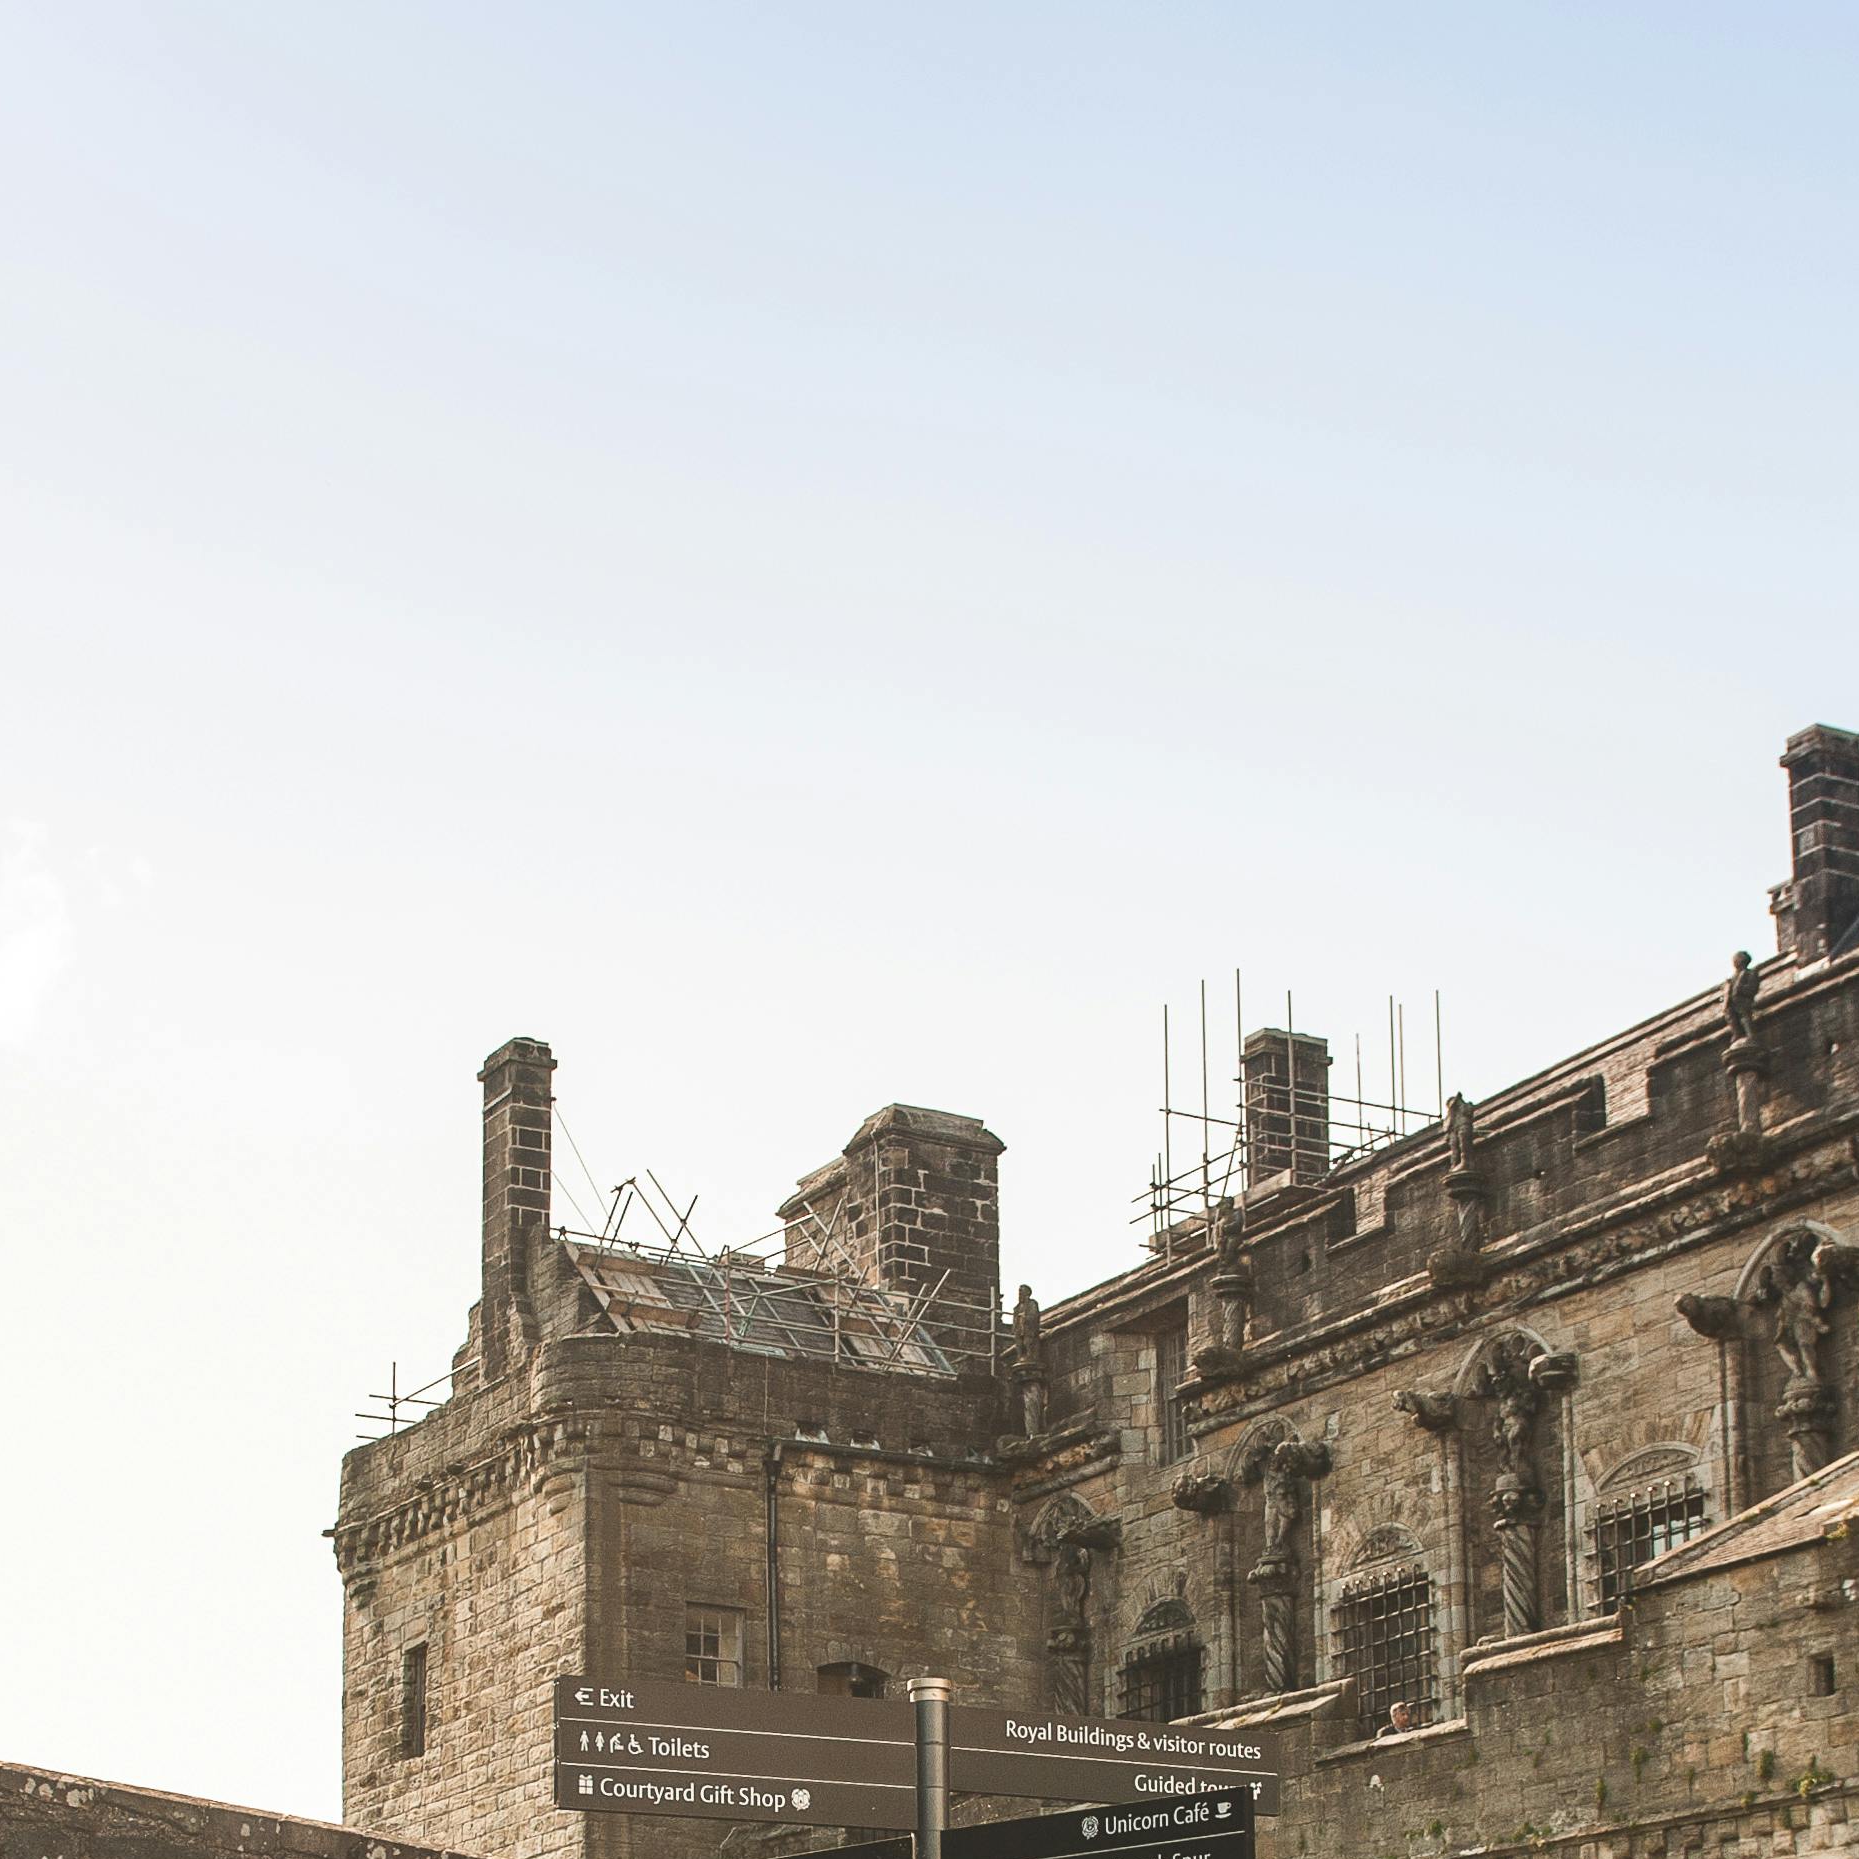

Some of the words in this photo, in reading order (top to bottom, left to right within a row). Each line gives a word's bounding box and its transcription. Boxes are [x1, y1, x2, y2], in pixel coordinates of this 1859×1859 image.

[600, 1688, 635, 1709] Exit
[647, 1736, 710, 1759] Toilets
[1006, 1719, 1052, 1744] Royal
[1056, 1724, 1135, 1752] Buildings
[1137, 1732, 1151, 1750] &
[1152, 1734, 1206, 1755] visitor
[1209, 1742, 1262, 1760] routes
[600, 1777, 695, 1805] Courtyard
[699, 1784, 735, 1805] Gift
[738, 1786, 786, 1813] Shop
[1134, 1774, 1196, 1795] Guided
[1105, 1813, 1169, 1835] Unicorn
[1173, 1801, 1210, 1825] Café
